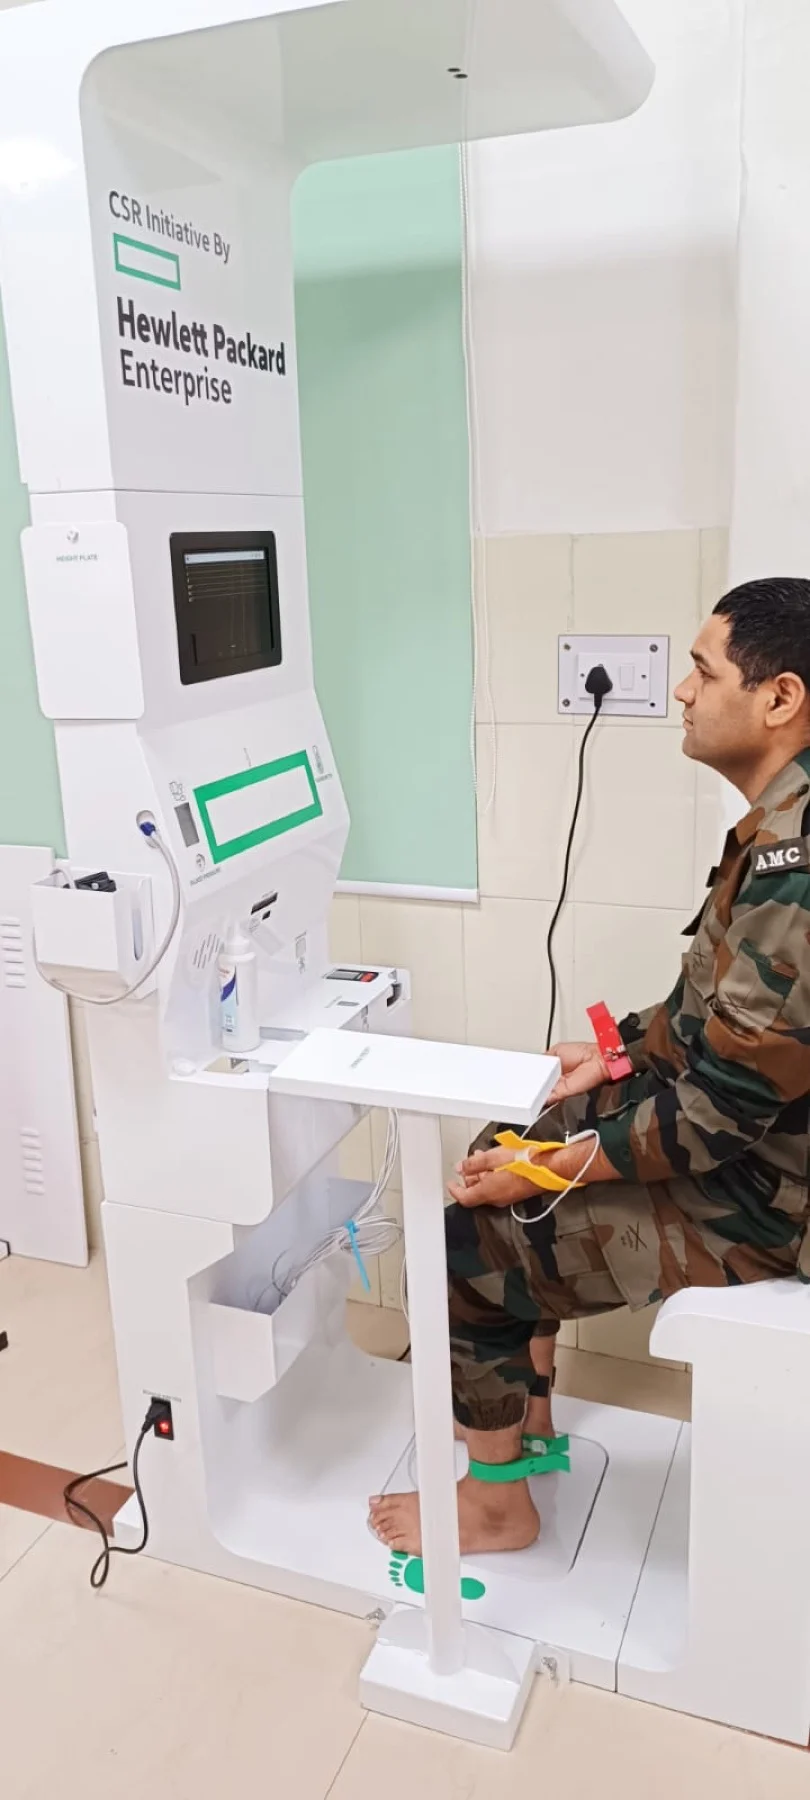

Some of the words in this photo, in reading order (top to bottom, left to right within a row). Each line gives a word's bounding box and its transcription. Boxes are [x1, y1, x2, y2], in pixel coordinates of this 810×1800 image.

[108, 190, 143, 227] CSR
[146, 204, 210, 252] Initiative
[213, 232, 231, 264] By
[116, 295, 209, 358] Hewlett
[212, 323, 287, 376] Packard
[119, 348, 232, 406] Enterprise
[79, 553, 98, 562] PLATE
[755, 847, 801, 871] AMC
